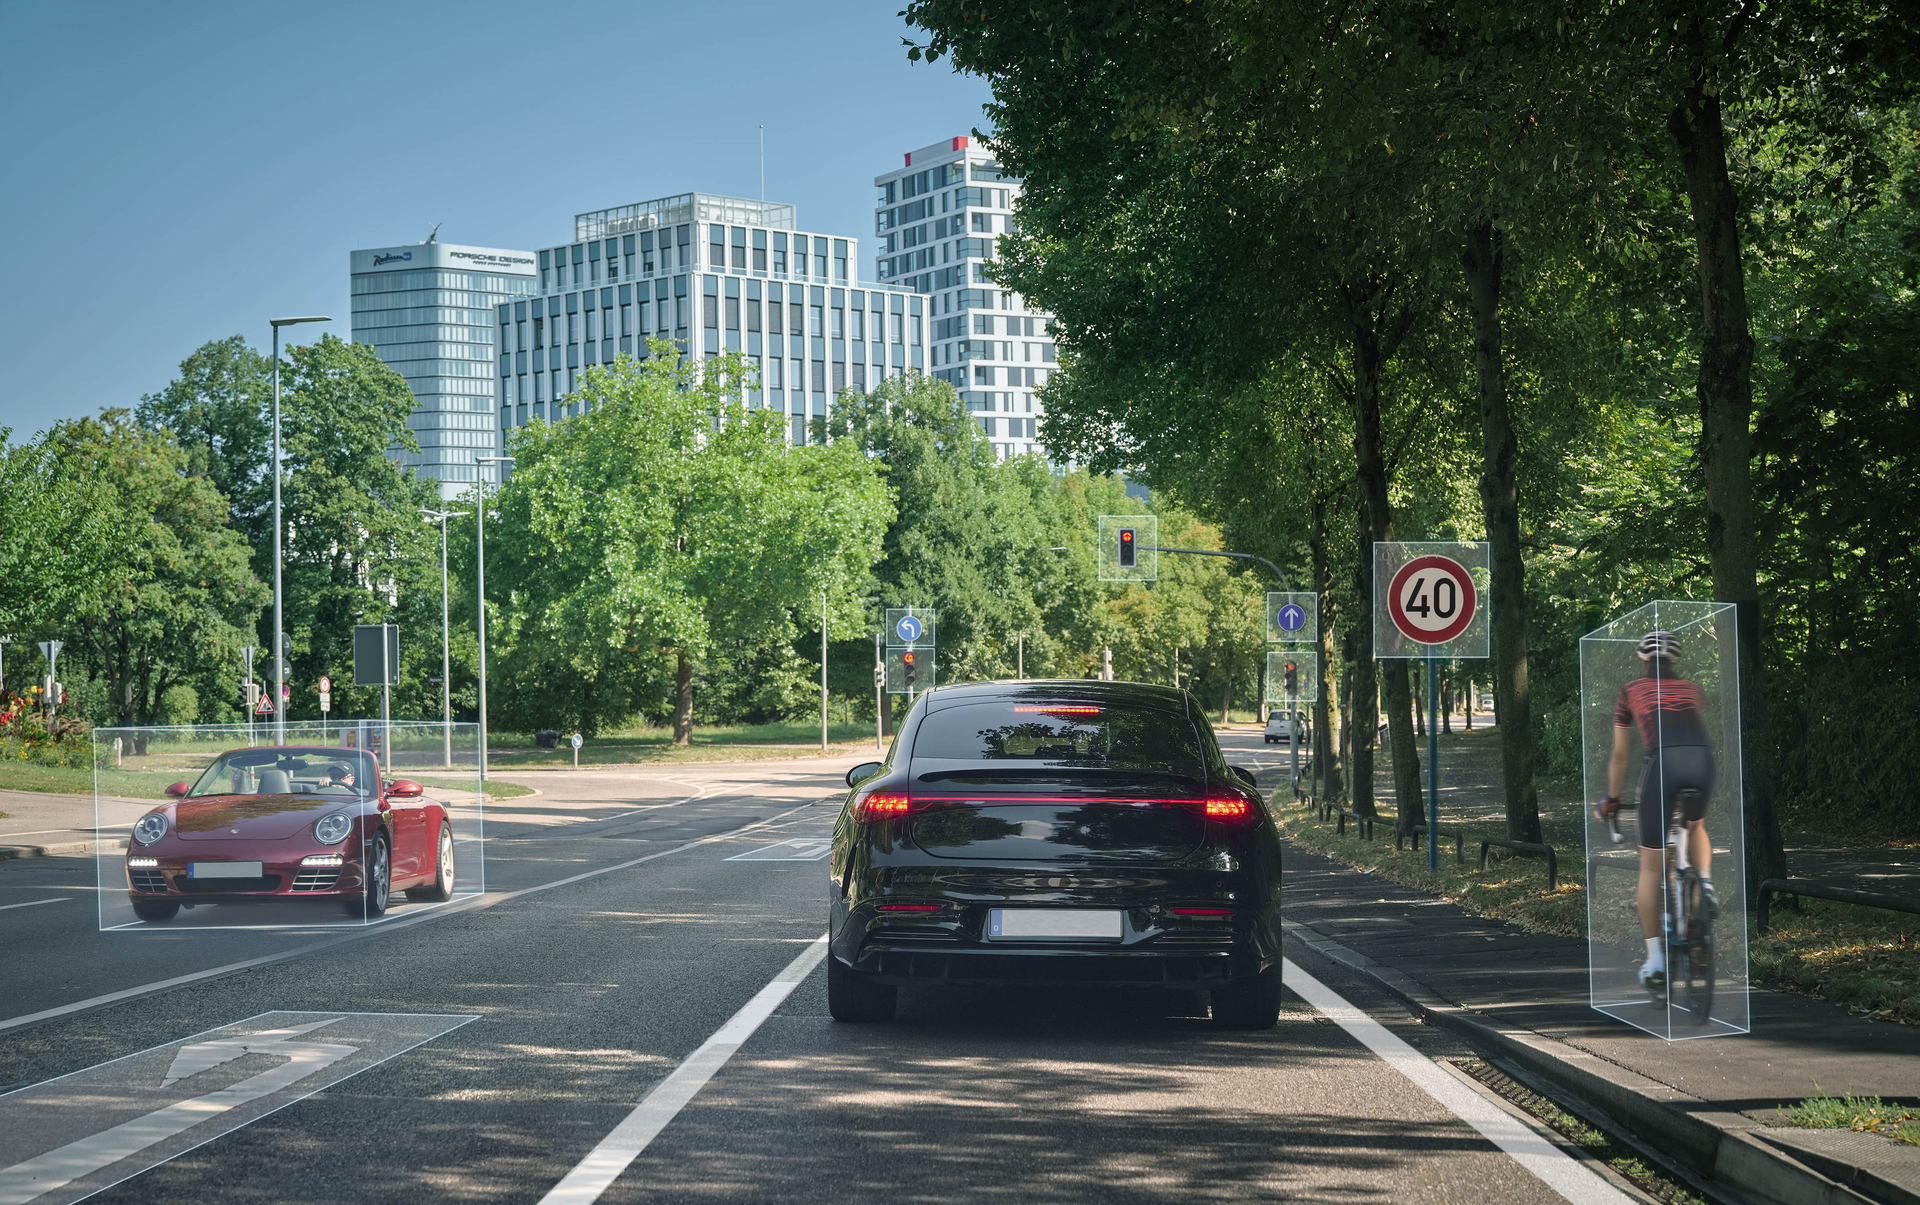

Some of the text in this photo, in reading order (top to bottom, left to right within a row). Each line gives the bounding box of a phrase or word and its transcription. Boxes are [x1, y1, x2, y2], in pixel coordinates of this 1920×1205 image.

[450, 251, 497, 261] PORSCHE
[499, 256, 534, 265] DESIGN
[1406, 577, 1456, 619] 40
